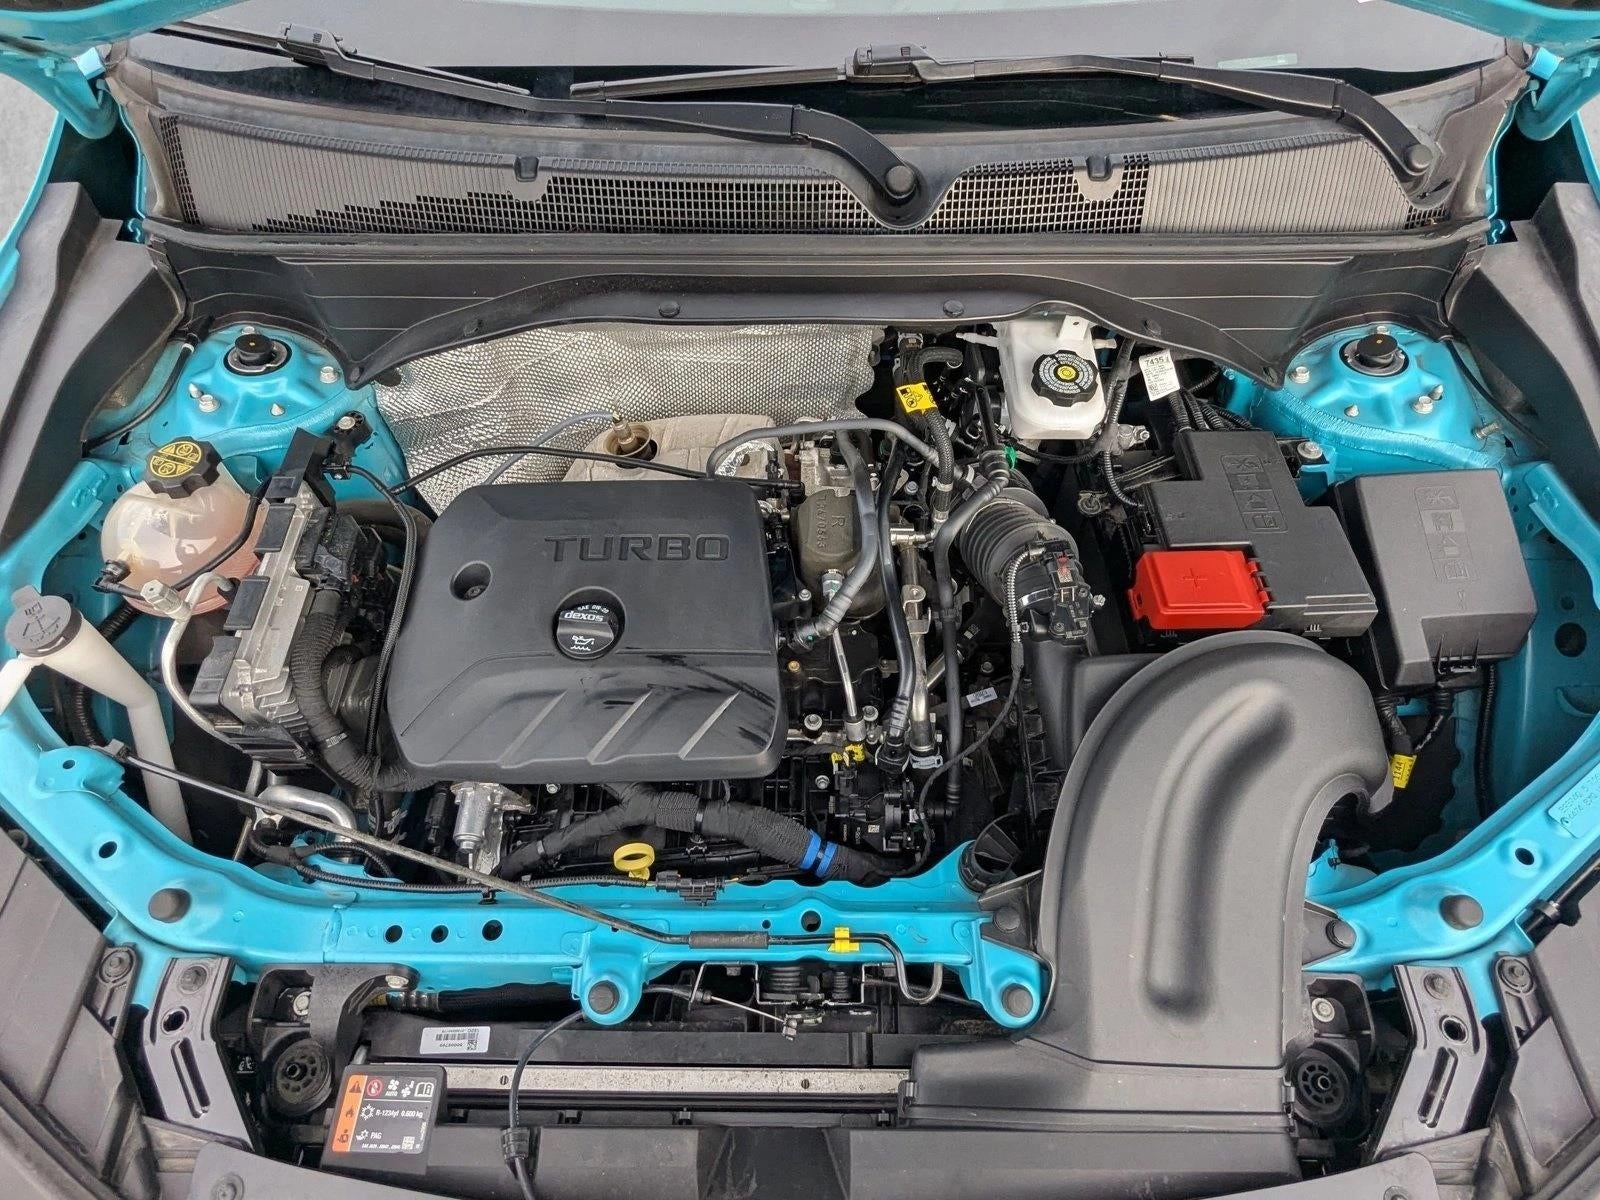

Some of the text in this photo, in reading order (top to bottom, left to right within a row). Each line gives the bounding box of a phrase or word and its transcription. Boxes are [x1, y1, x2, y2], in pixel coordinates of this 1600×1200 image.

[1144, 356, 1164, 366] 7435
[544, 533, 730, 562] TURBO
[564, 610, 604, 622] dexos
[416, 1110, 424, 1118] kg
[370, 1131, 382, 1139] PAG
